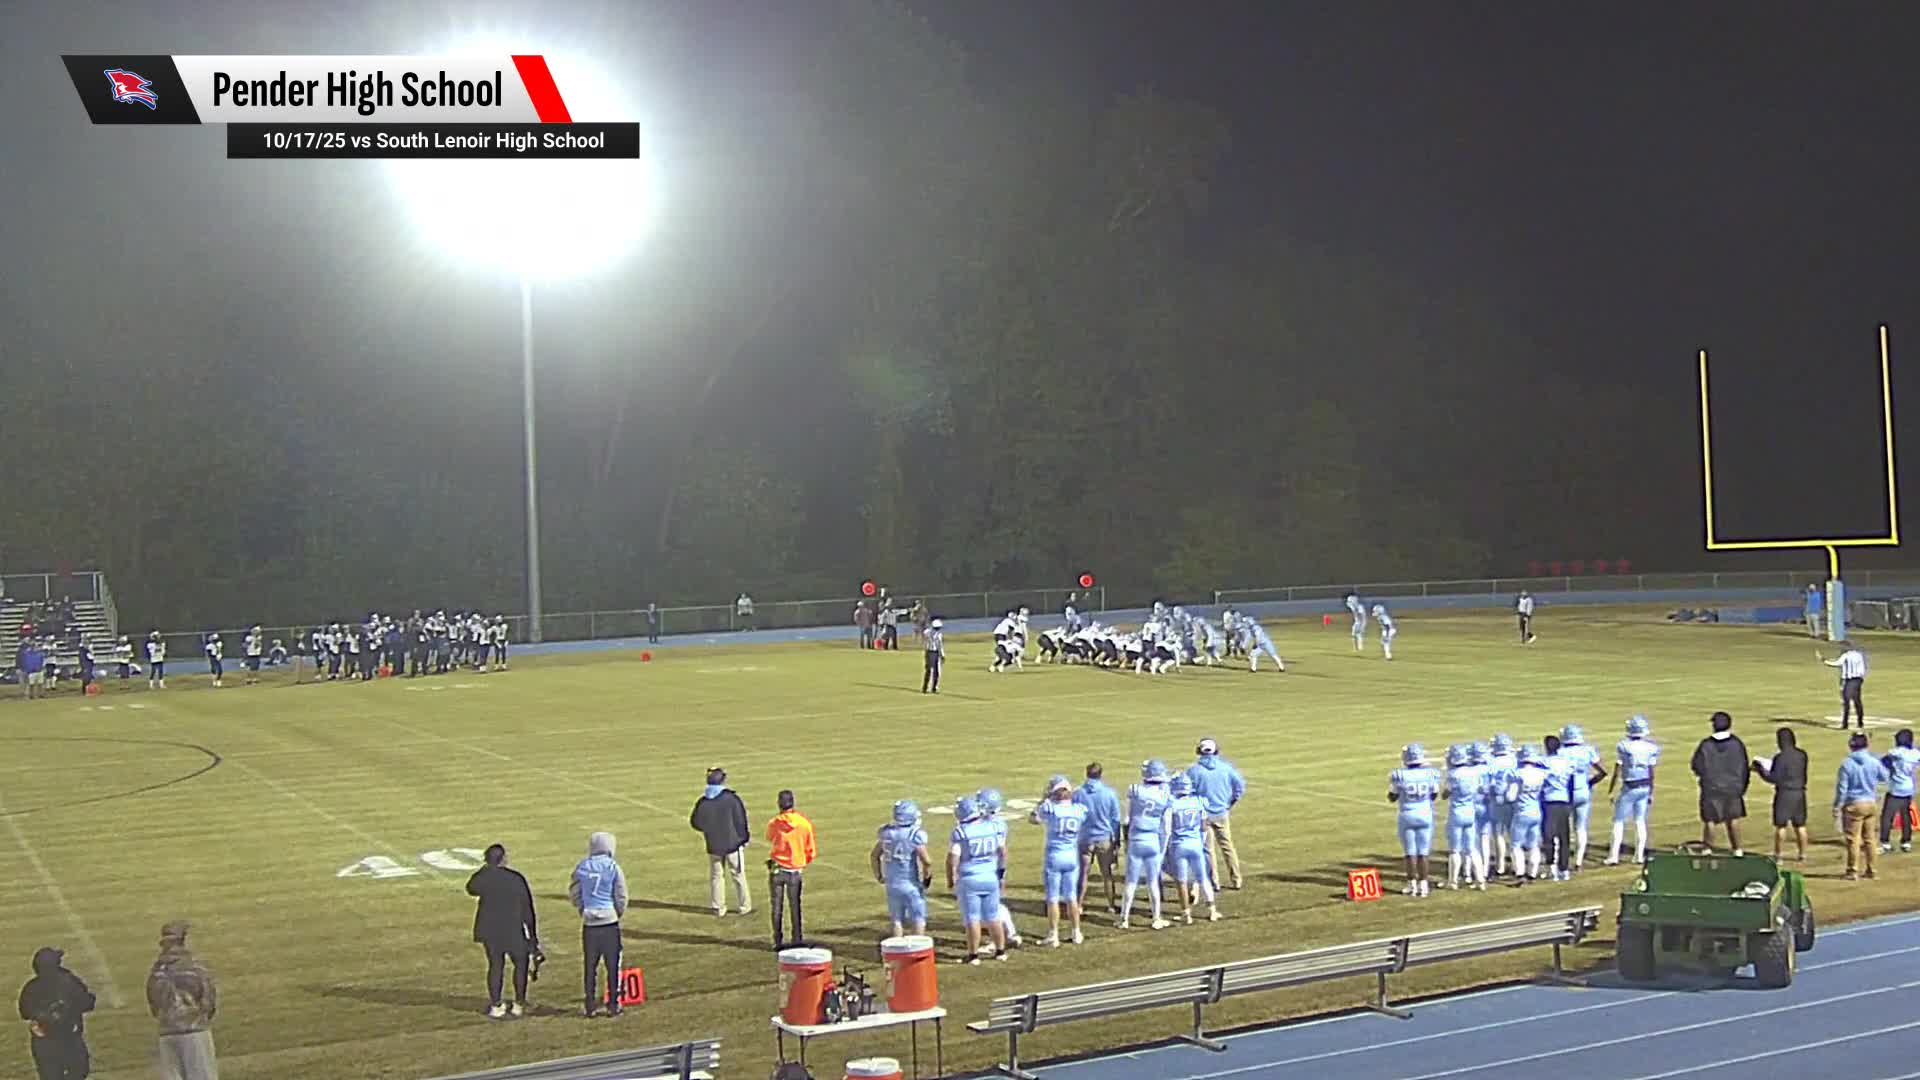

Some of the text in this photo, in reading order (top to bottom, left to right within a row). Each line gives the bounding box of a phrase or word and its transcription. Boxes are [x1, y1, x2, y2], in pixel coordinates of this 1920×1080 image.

[1141, 799, 1156, 817] 2
[1177, 809, 1198, 827] 17
[968, 838, 996, 857] 70
[588, 873, 602, 897] 7
[1352, 873, 1376, 898] 30
